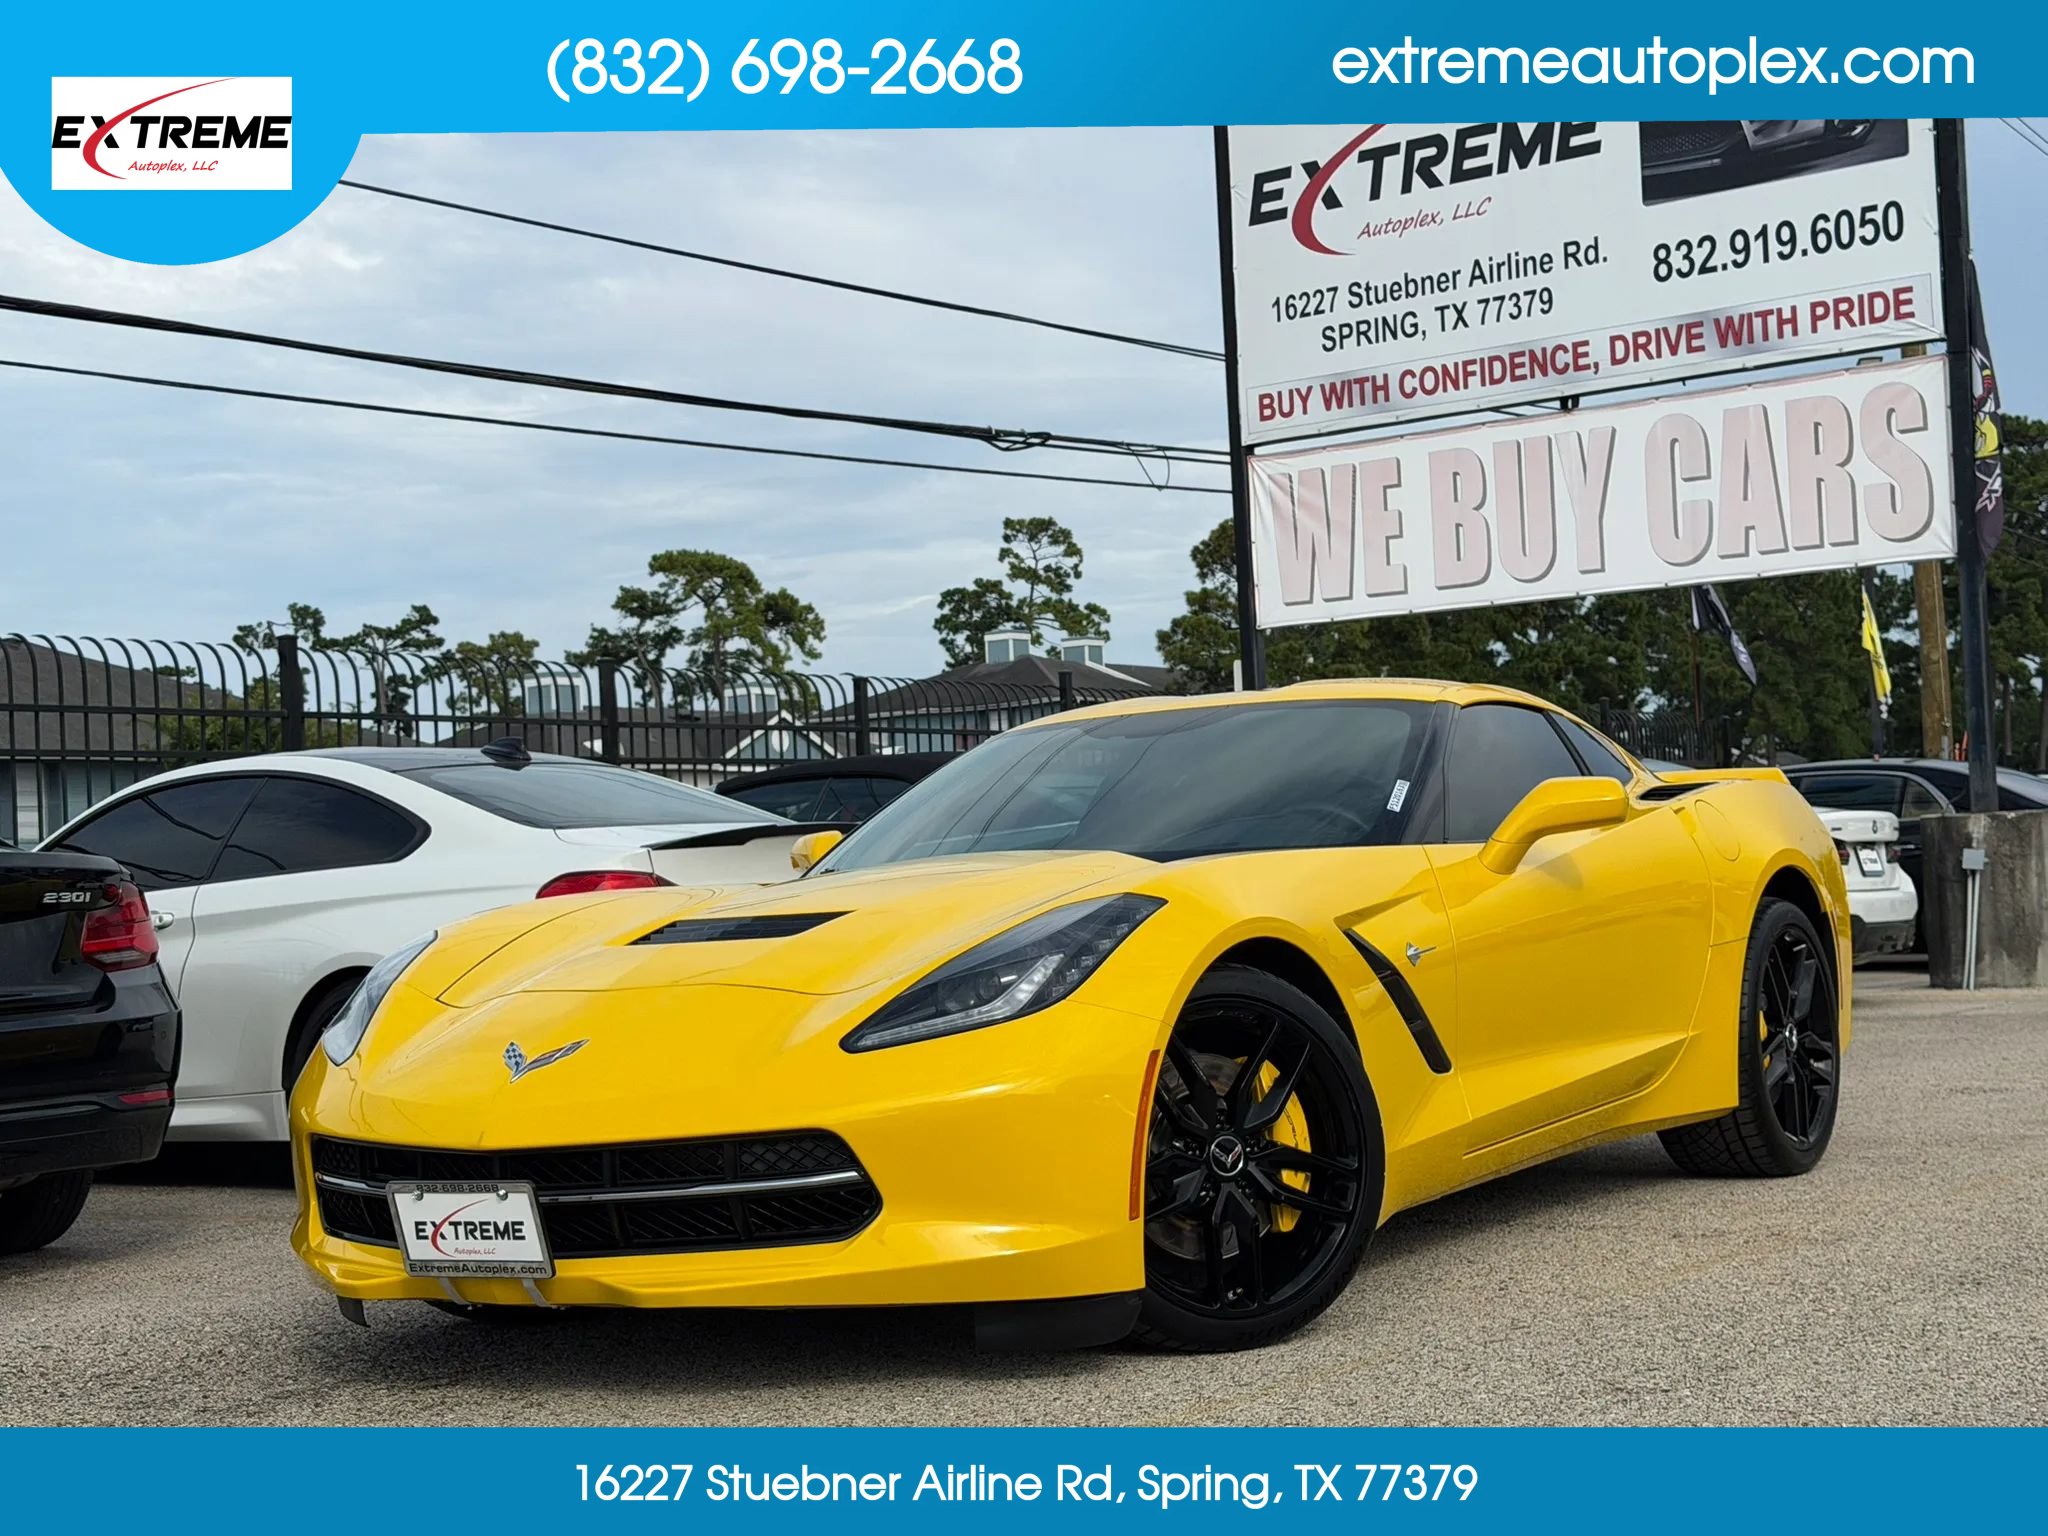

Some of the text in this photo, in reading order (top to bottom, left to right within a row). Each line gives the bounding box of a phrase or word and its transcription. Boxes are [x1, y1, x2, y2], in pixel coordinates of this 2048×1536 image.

[1248, 122, 1602, 226] EXTREME
[1357, 197, 1492, 240] Autoplex, LLC
[1652, 200, 1905, 283] 832.919.6050
[1271, 236, 1609, 324] 16227 Stuebner Airline Rd.
[1258, 286, 1915, 422] BUY WITH CONFIDENCE, DRIVE WITH PRIDE
[1321, 286, 1554, 353] SPRING, TX 77379
[1273, 381, 1935, 606] WE BUY CARS
[414, 1220, 526, 1241] EXTREME
[483, 1247, 496, 1255] LLC
[409, 1262, 547, 1275] ExtremeAutoplex.com
